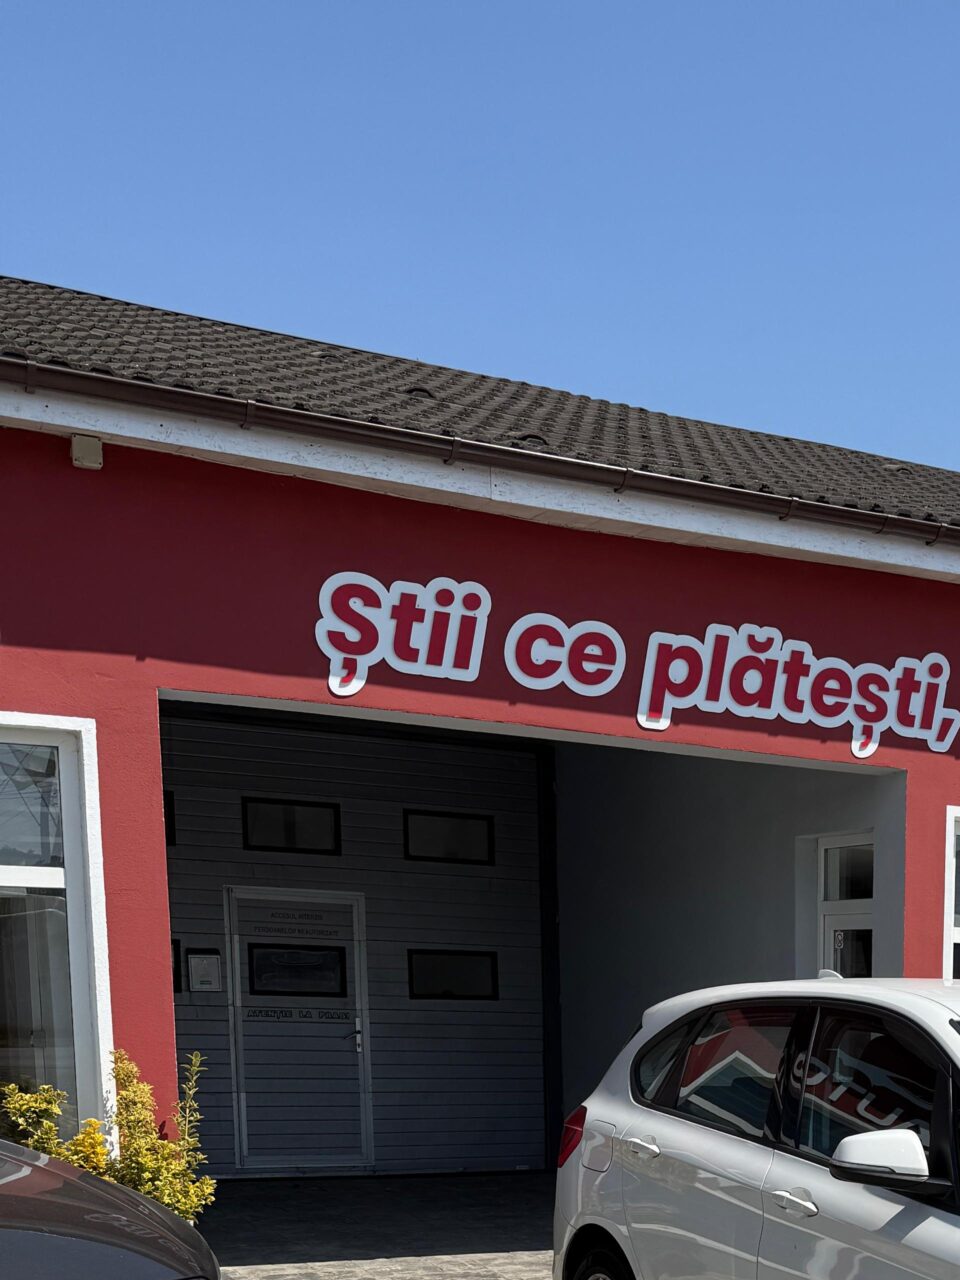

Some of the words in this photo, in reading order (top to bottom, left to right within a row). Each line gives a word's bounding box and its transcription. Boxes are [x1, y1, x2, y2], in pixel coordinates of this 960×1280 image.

[324, 580, 485, 690] Știi
[513, 621, 619, 687] ce
[644, 632, 958, 752] plătești,
